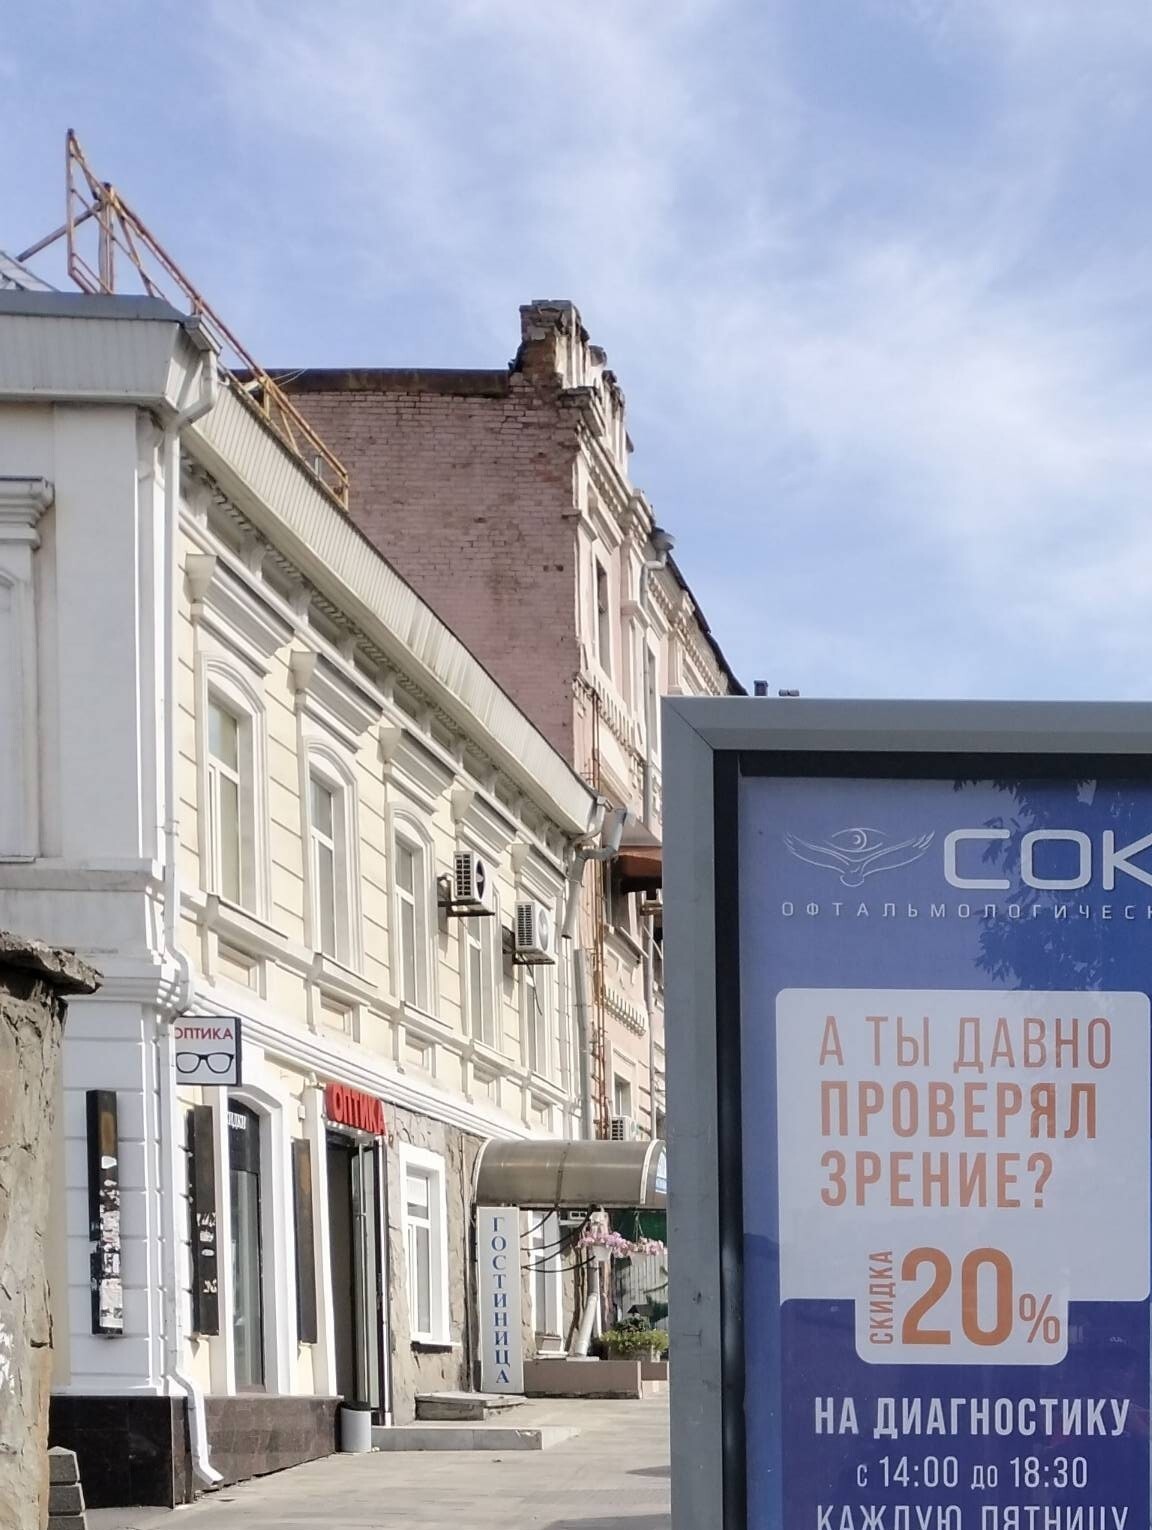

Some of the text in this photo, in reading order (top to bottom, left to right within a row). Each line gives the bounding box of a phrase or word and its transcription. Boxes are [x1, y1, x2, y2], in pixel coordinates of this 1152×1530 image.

[174, 1027, 233, 1040] ОПТИКА
[818, 1015, 1112, 1074] А ТЫ ДАВНО
[332, 1084, 384, 1133] ОПТИКА
[820, 1080, 1097, 1139] ПРОВЕРЯЛ
[820, 1149, 1053, 1209] ЗРЕНИЕ?
[490, 1216, 511, 1384] ГОСТИНИЦА
[868, 1249, 897, 1345] СКИДКА
[900, 1246, 1062, 1347] 20%
[814, 1397, 1131, 1440] НА ДИАГНОСТИКУ
[878, 1455, 960, 1488] 14:00
[1010, 1456, 1089, 1489] 18:30
